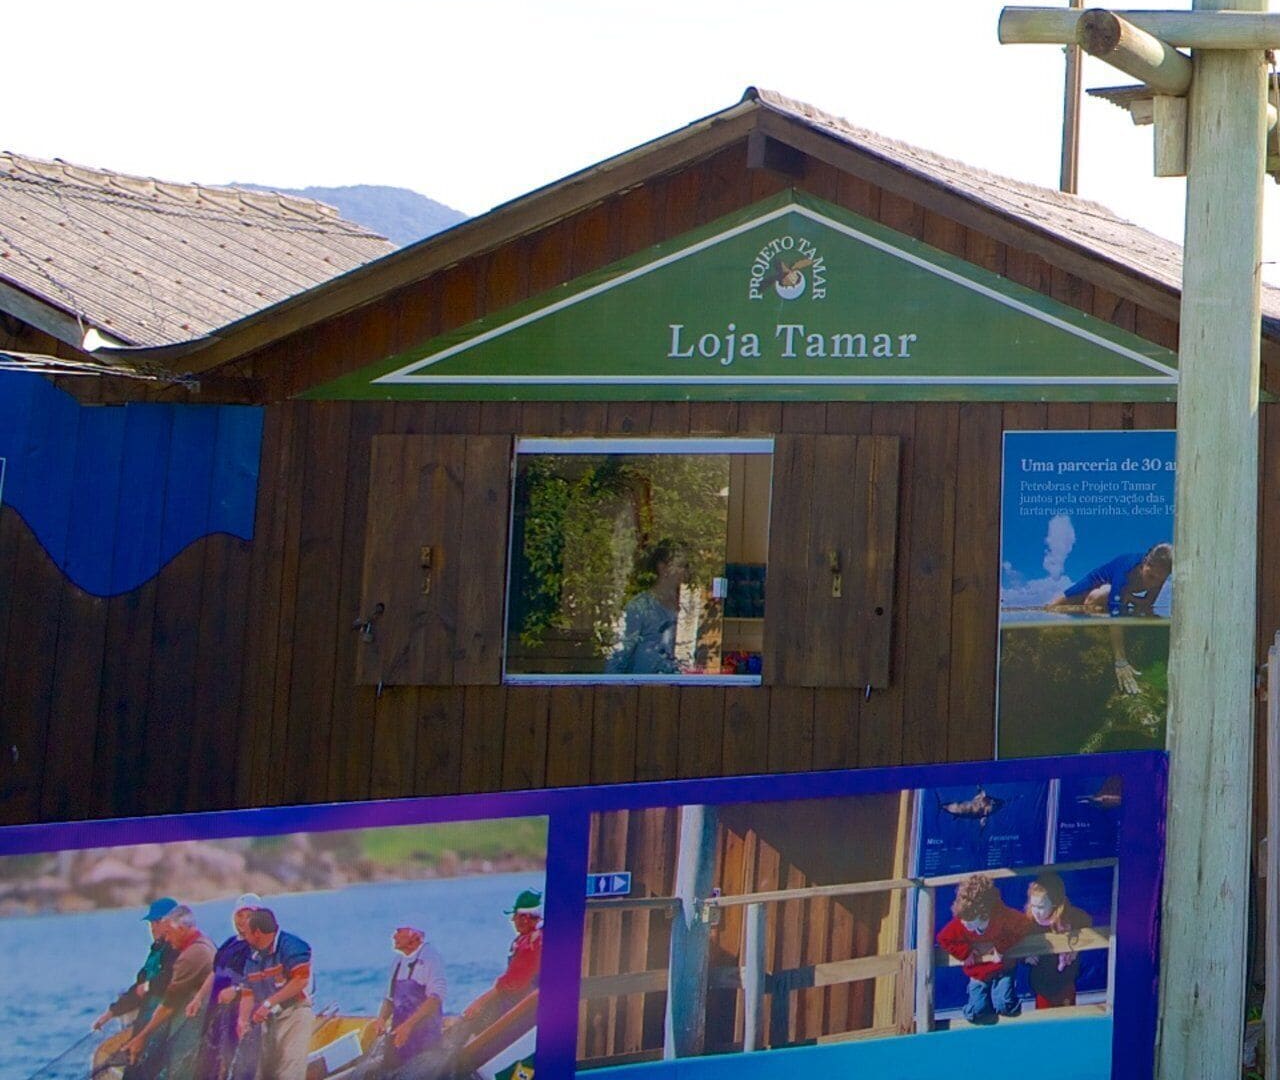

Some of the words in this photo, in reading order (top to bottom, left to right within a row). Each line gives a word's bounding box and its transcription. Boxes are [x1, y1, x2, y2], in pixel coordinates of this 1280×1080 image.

[749, 236, 793, 300] PROJETO
[798, 237, 827, 300] TAMAR
[667, 323, 761, 365] Loja
[775, 324, 917, 358] Tamar
[1021, 459, 1054, 472] Uma
[1058, 459, 1117, 475] parceria
[1121, 458, 1139, 471] de
[1142, 458, 1162, 471] 30
[1020, 480, 1072, 492] Petrobras
[1081, 480, 1120, 495] Projeto
[1122, 480, 1157, 491] Tamar
[1019, 493, 1052, 505] juntos
[1055, 493, 1077, 506] pela
[1079, 493, 1144, 505] conservação
[1146, 492, 1165, 503] das
[1132, 504, 1162, 515] desde
